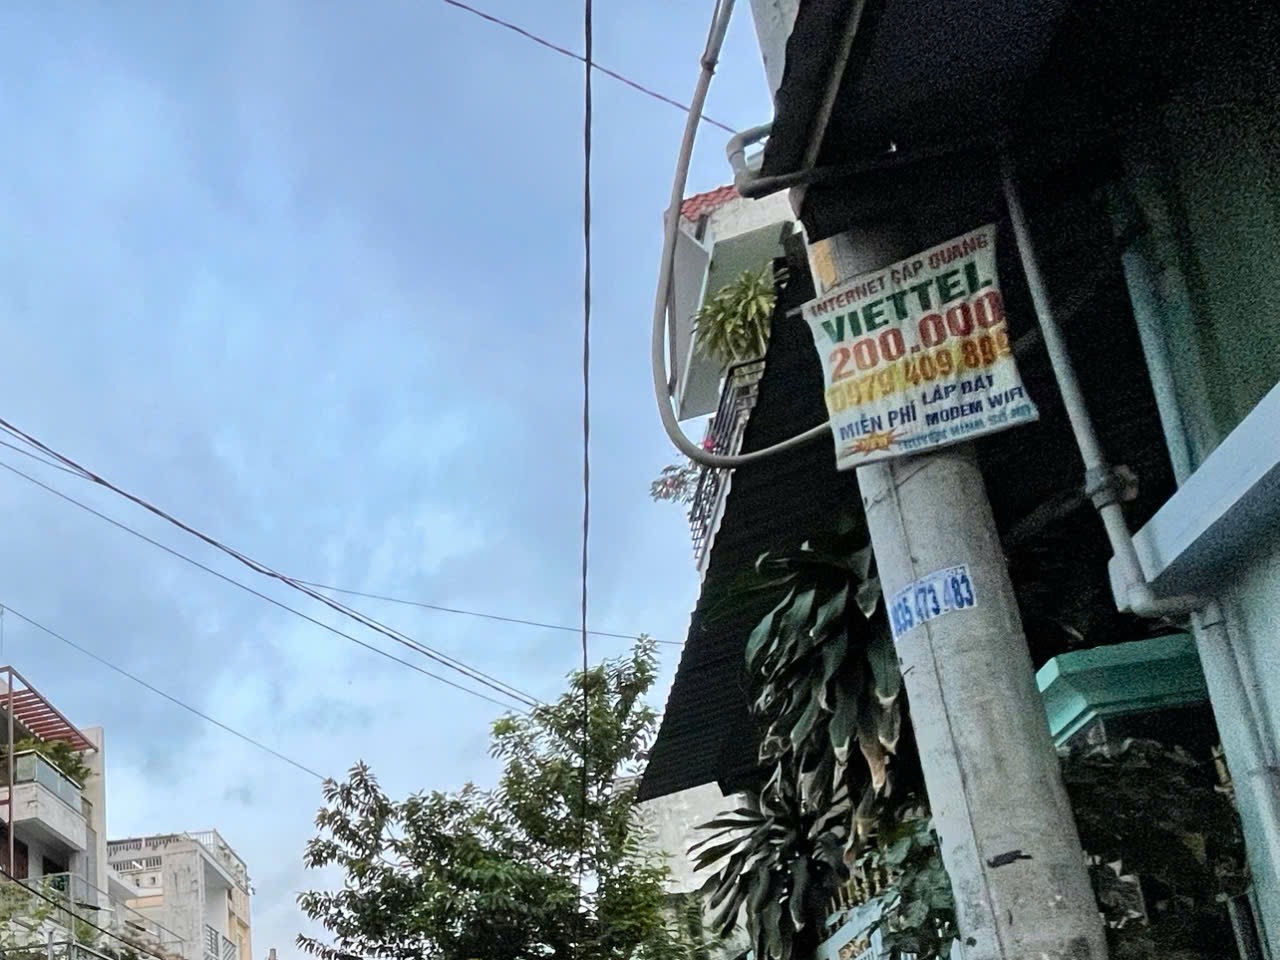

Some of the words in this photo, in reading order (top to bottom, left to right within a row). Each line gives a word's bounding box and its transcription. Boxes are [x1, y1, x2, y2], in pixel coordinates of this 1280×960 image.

[810, 276, 886, 318] INTERNET
[821, 261, 994, 345] VIETTEL
[829, 289, 1005, 383] 200.000
[903, 350, 954, 386] 409
[925, 399, 984, 427] MODEM
